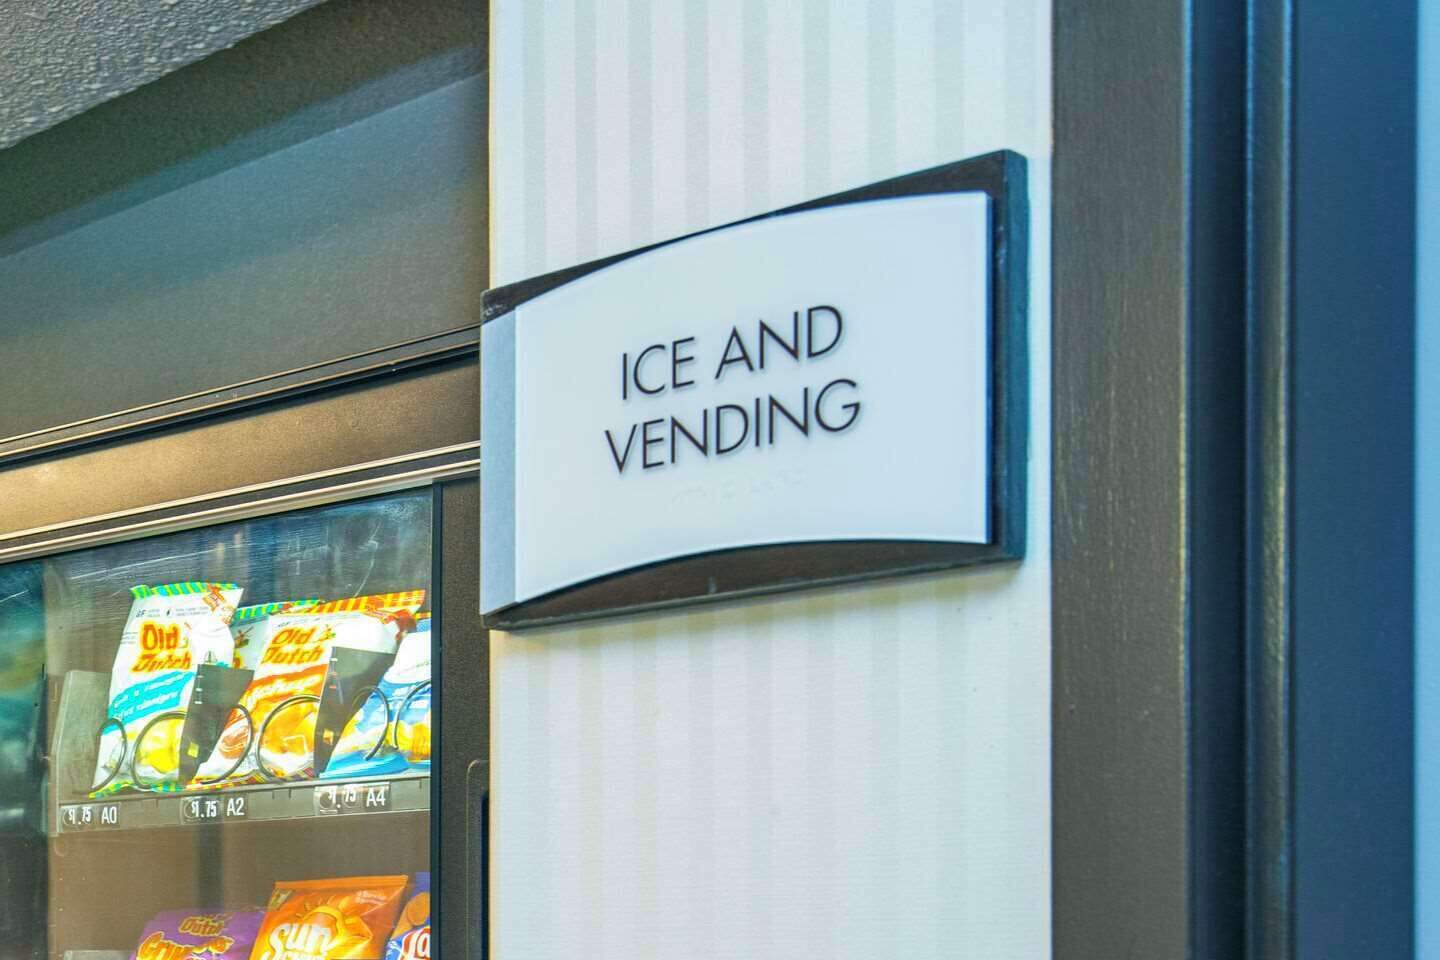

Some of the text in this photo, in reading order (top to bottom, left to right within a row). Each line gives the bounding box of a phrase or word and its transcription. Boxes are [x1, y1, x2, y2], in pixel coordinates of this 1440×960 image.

[623, 305, 843, 400] ICE AND
[604, 378, 861, 474] VENDING
[141, 621, 180, 651] Old
[271, 625, 317, 646] Old
[227, 797, 245, 816] A2
[366, 787, 386, 807] A4
[101, 806, 117, 824] A0
